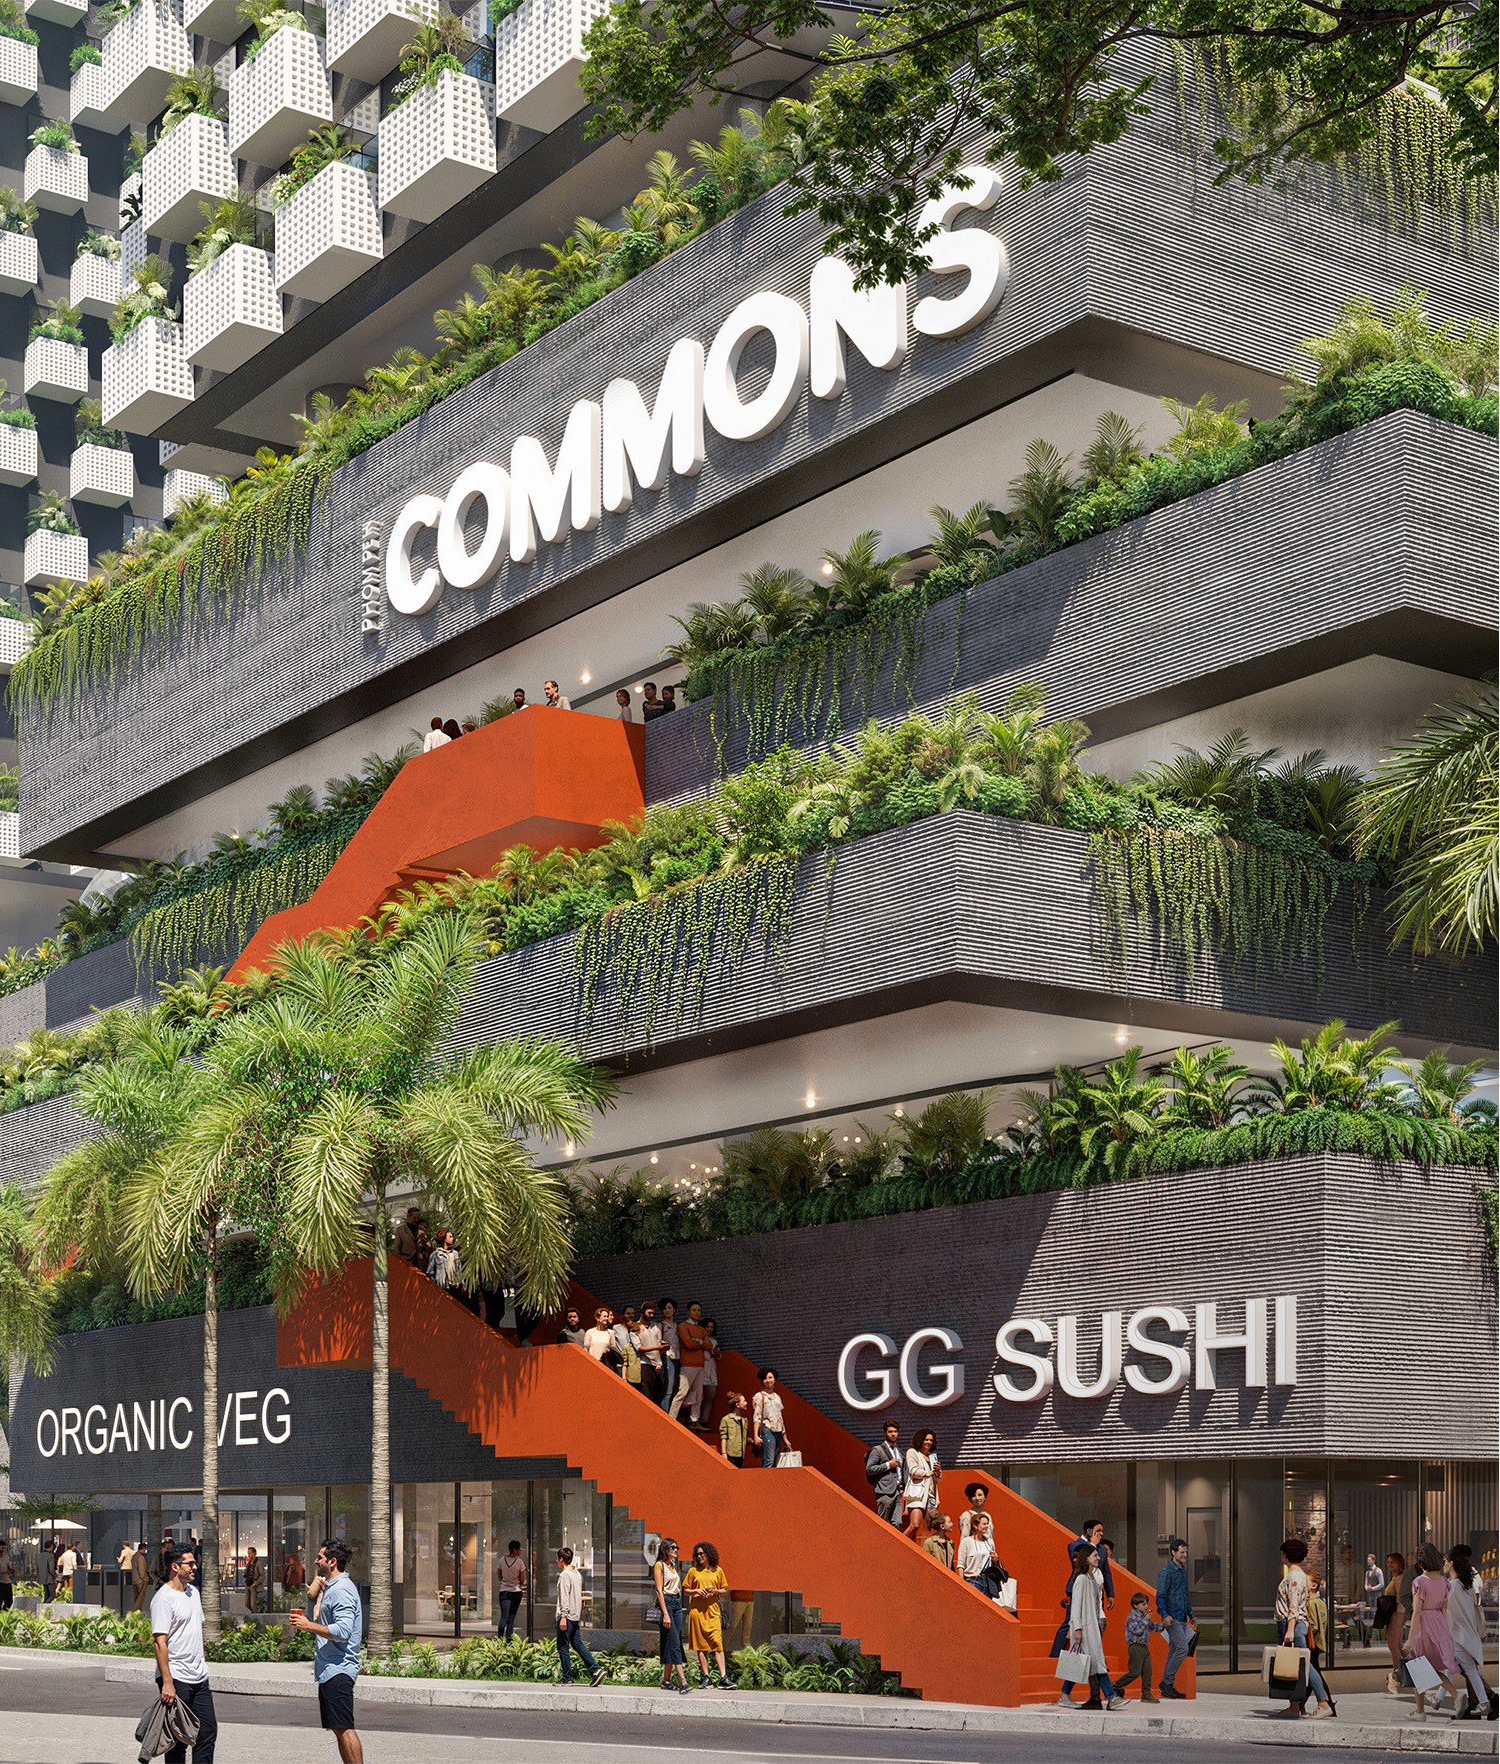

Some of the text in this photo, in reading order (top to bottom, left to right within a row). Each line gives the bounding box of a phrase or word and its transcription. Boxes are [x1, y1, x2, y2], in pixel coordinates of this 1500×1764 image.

[386, 165, 1007, 616] COMMONS
[837, 1295, 1298, 1411] GG SUSHI
[37, 1387, 292, 1458] ORGANIC VEG
